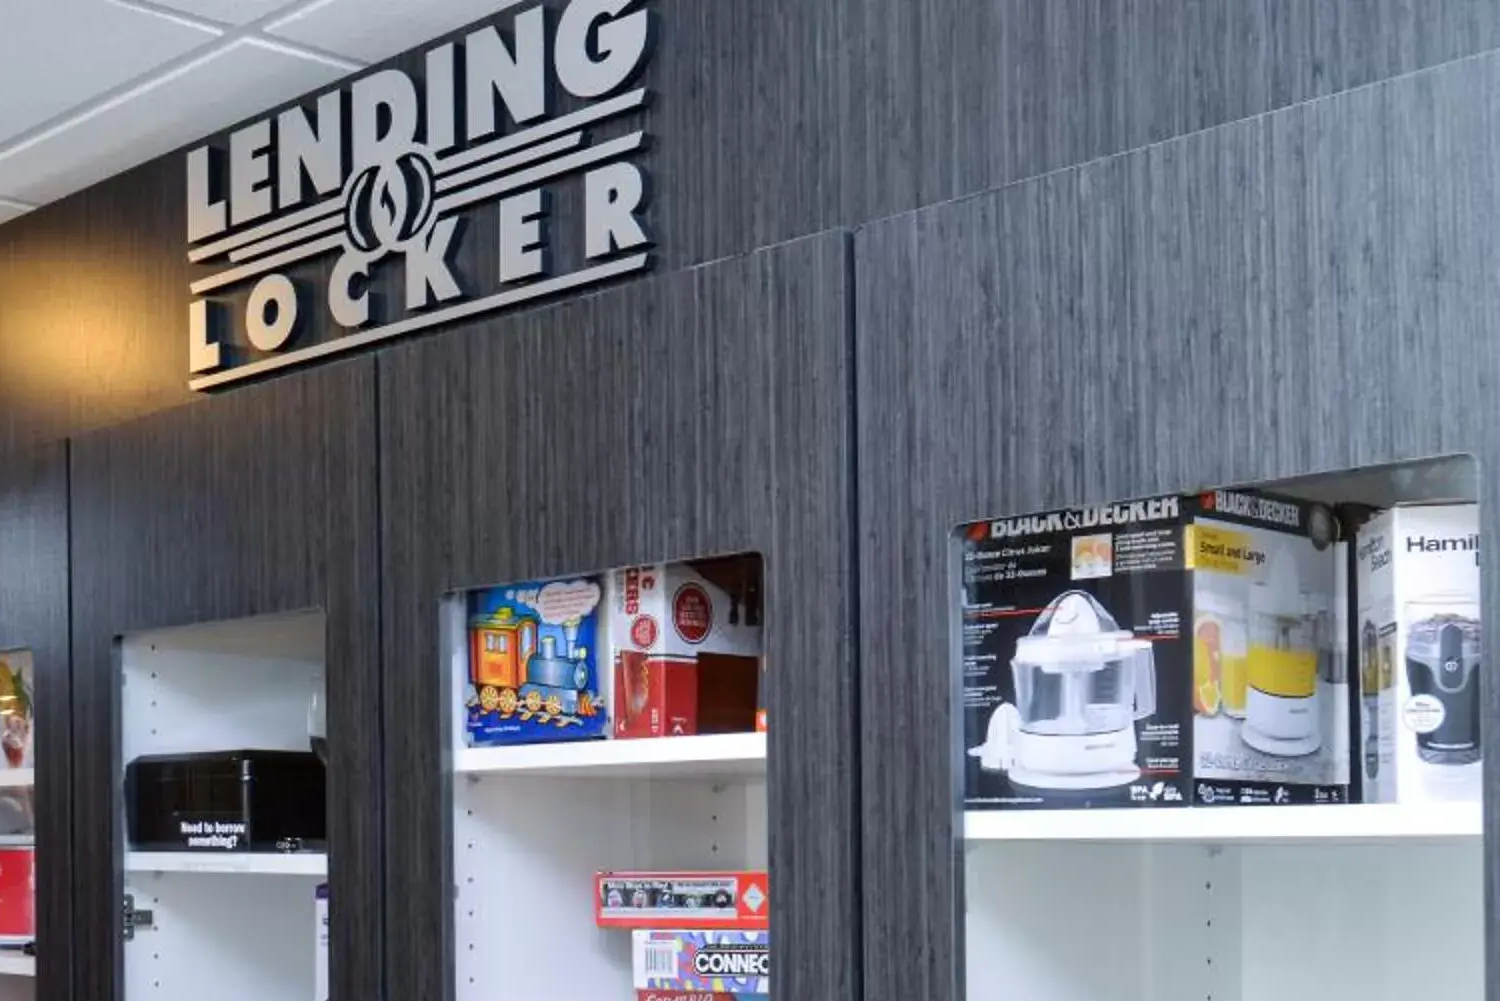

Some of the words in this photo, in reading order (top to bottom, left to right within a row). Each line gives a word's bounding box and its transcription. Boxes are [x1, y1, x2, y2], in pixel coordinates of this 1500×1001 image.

[187, 0, 648, 244] LENDING
[189, 161, 648, 373] LOCKER
[1406, 532, 1480, 553] Hamil
